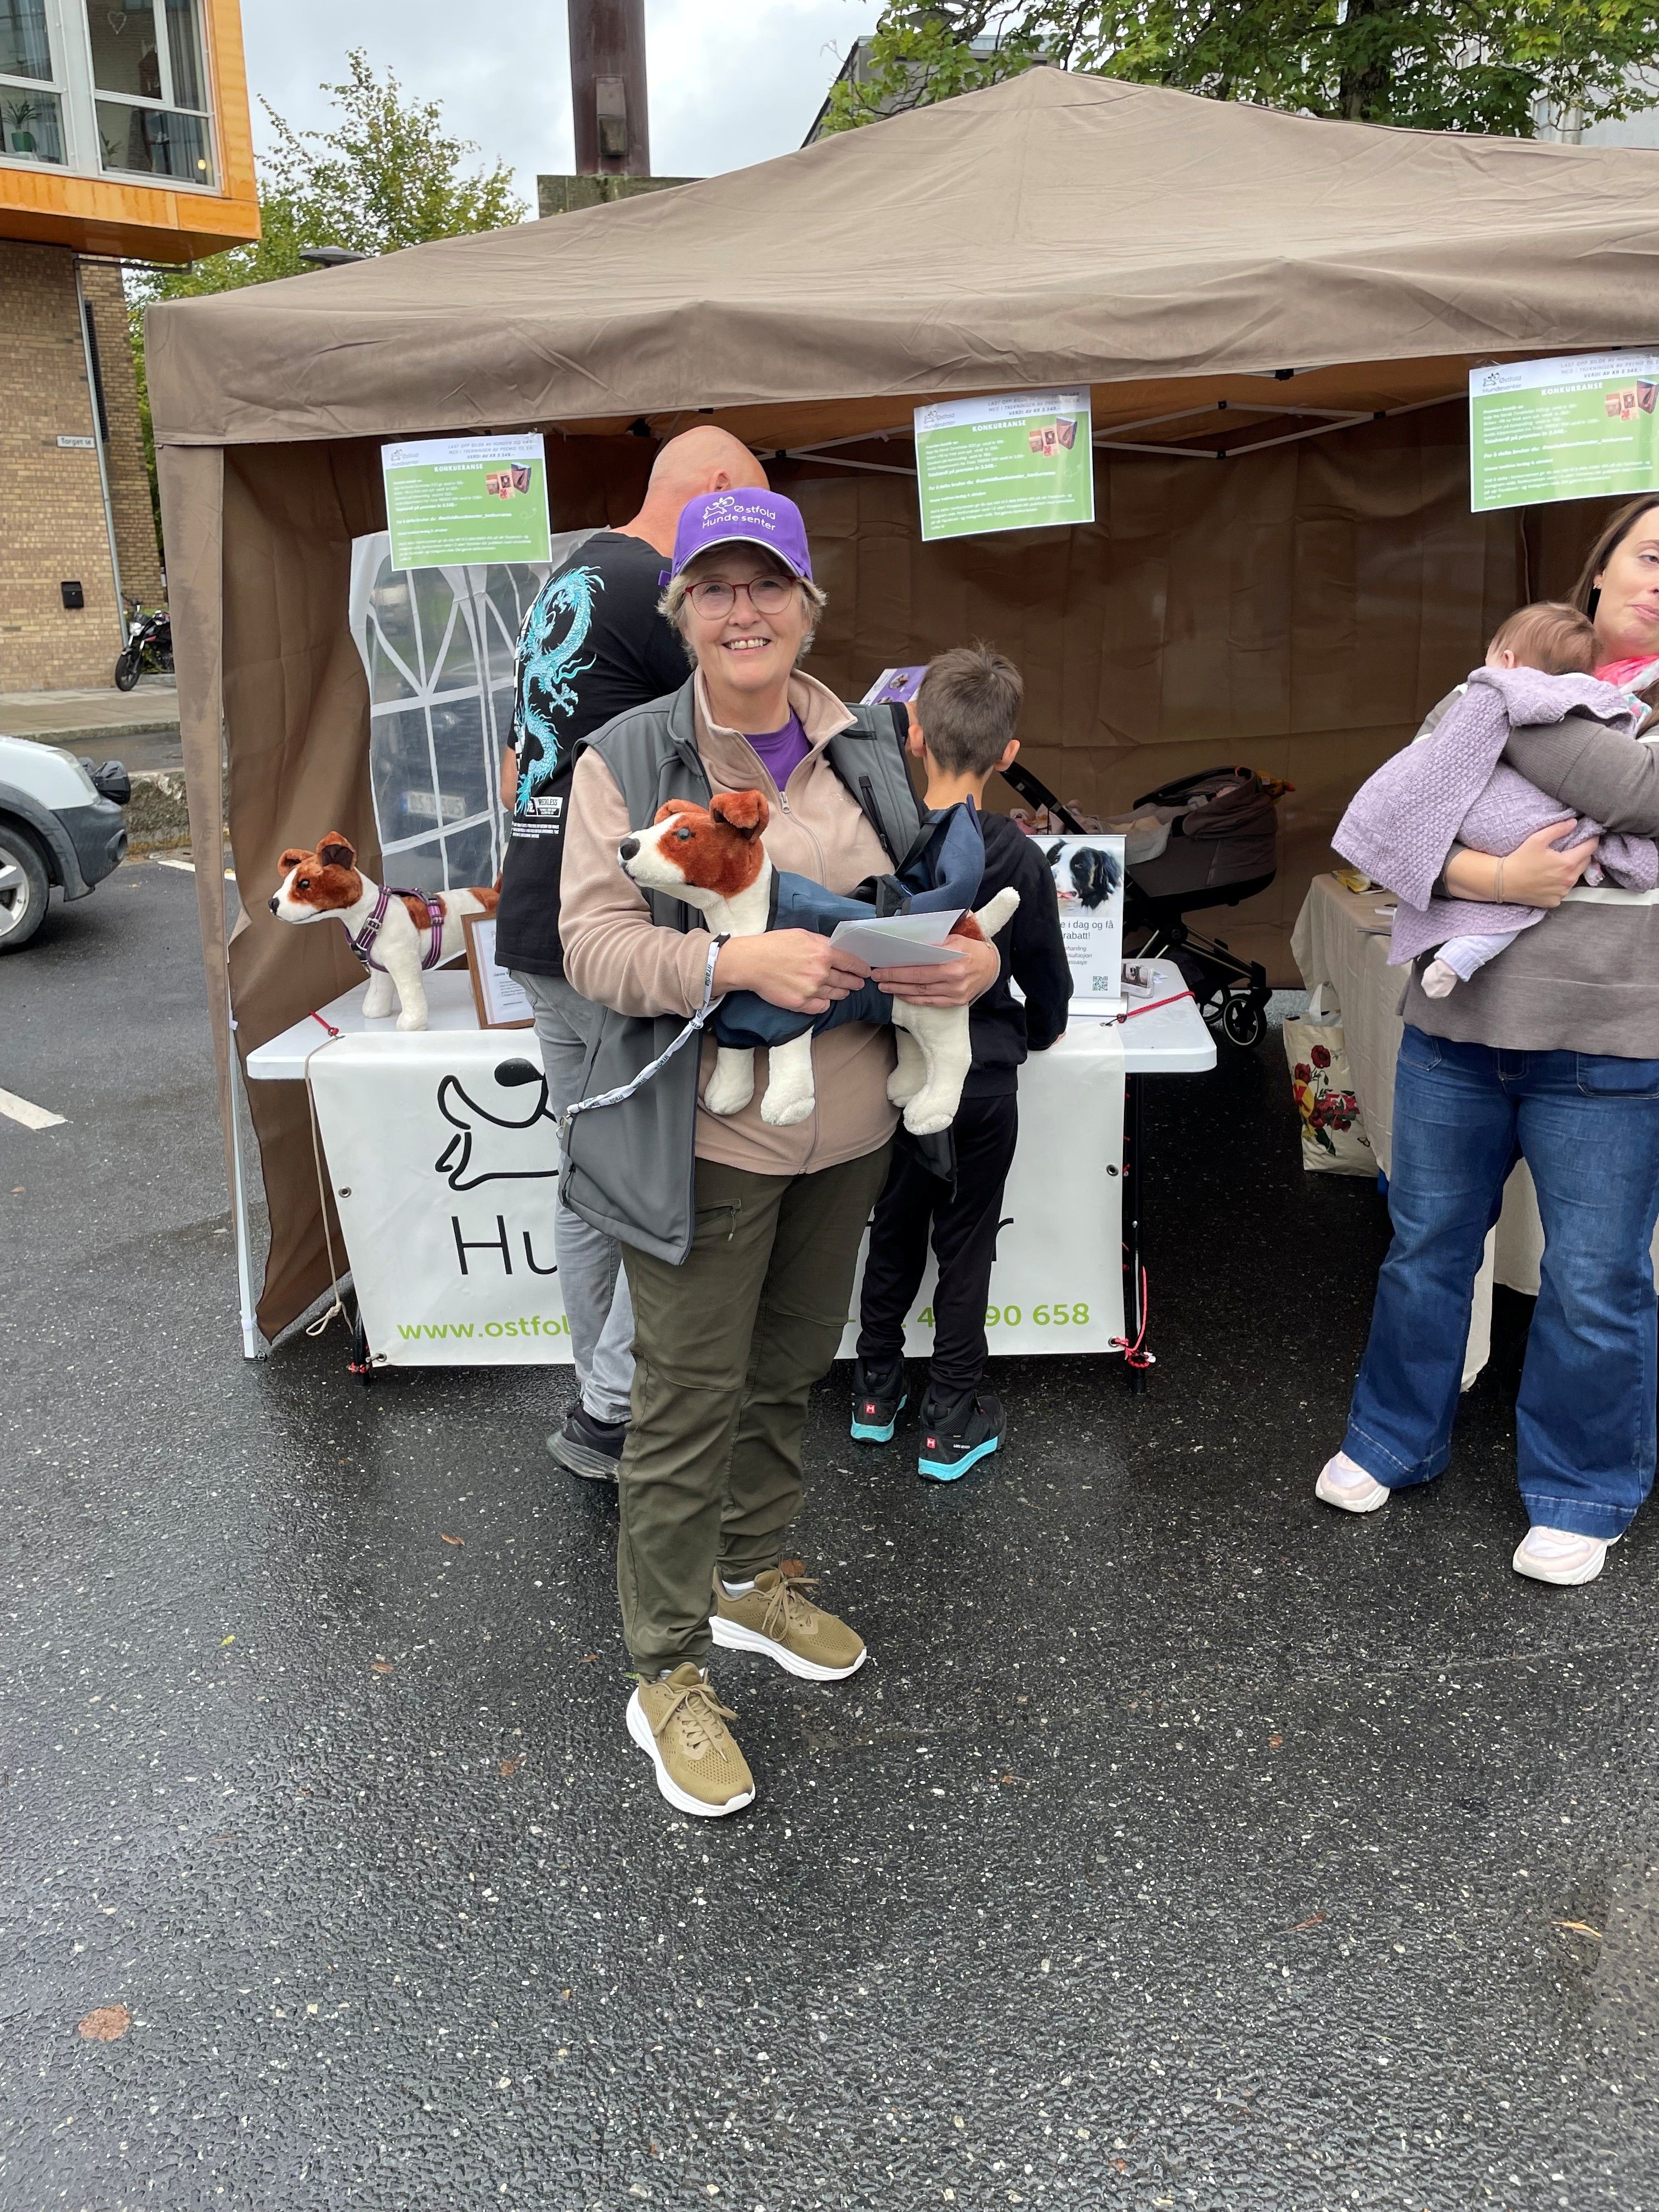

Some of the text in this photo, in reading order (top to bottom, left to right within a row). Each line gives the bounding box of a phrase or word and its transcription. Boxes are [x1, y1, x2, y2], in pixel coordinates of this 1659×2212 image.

[1541, 382, 1602, 396] KONKURRANSE
[972, 420, 1026, 432] KONKURRANSE
[434, 463, 483, 472] KONKURRANSE
[733, 505, 776, 520] Østfold
[1073, 921, 1089, 930] dag
[1092, 922, 1102, 930] og
[1105, 920, 1114, 929] få
[397, 1314, 572, 1340] www.ostfol
[1032, 1302, 1090, 1326] 658
